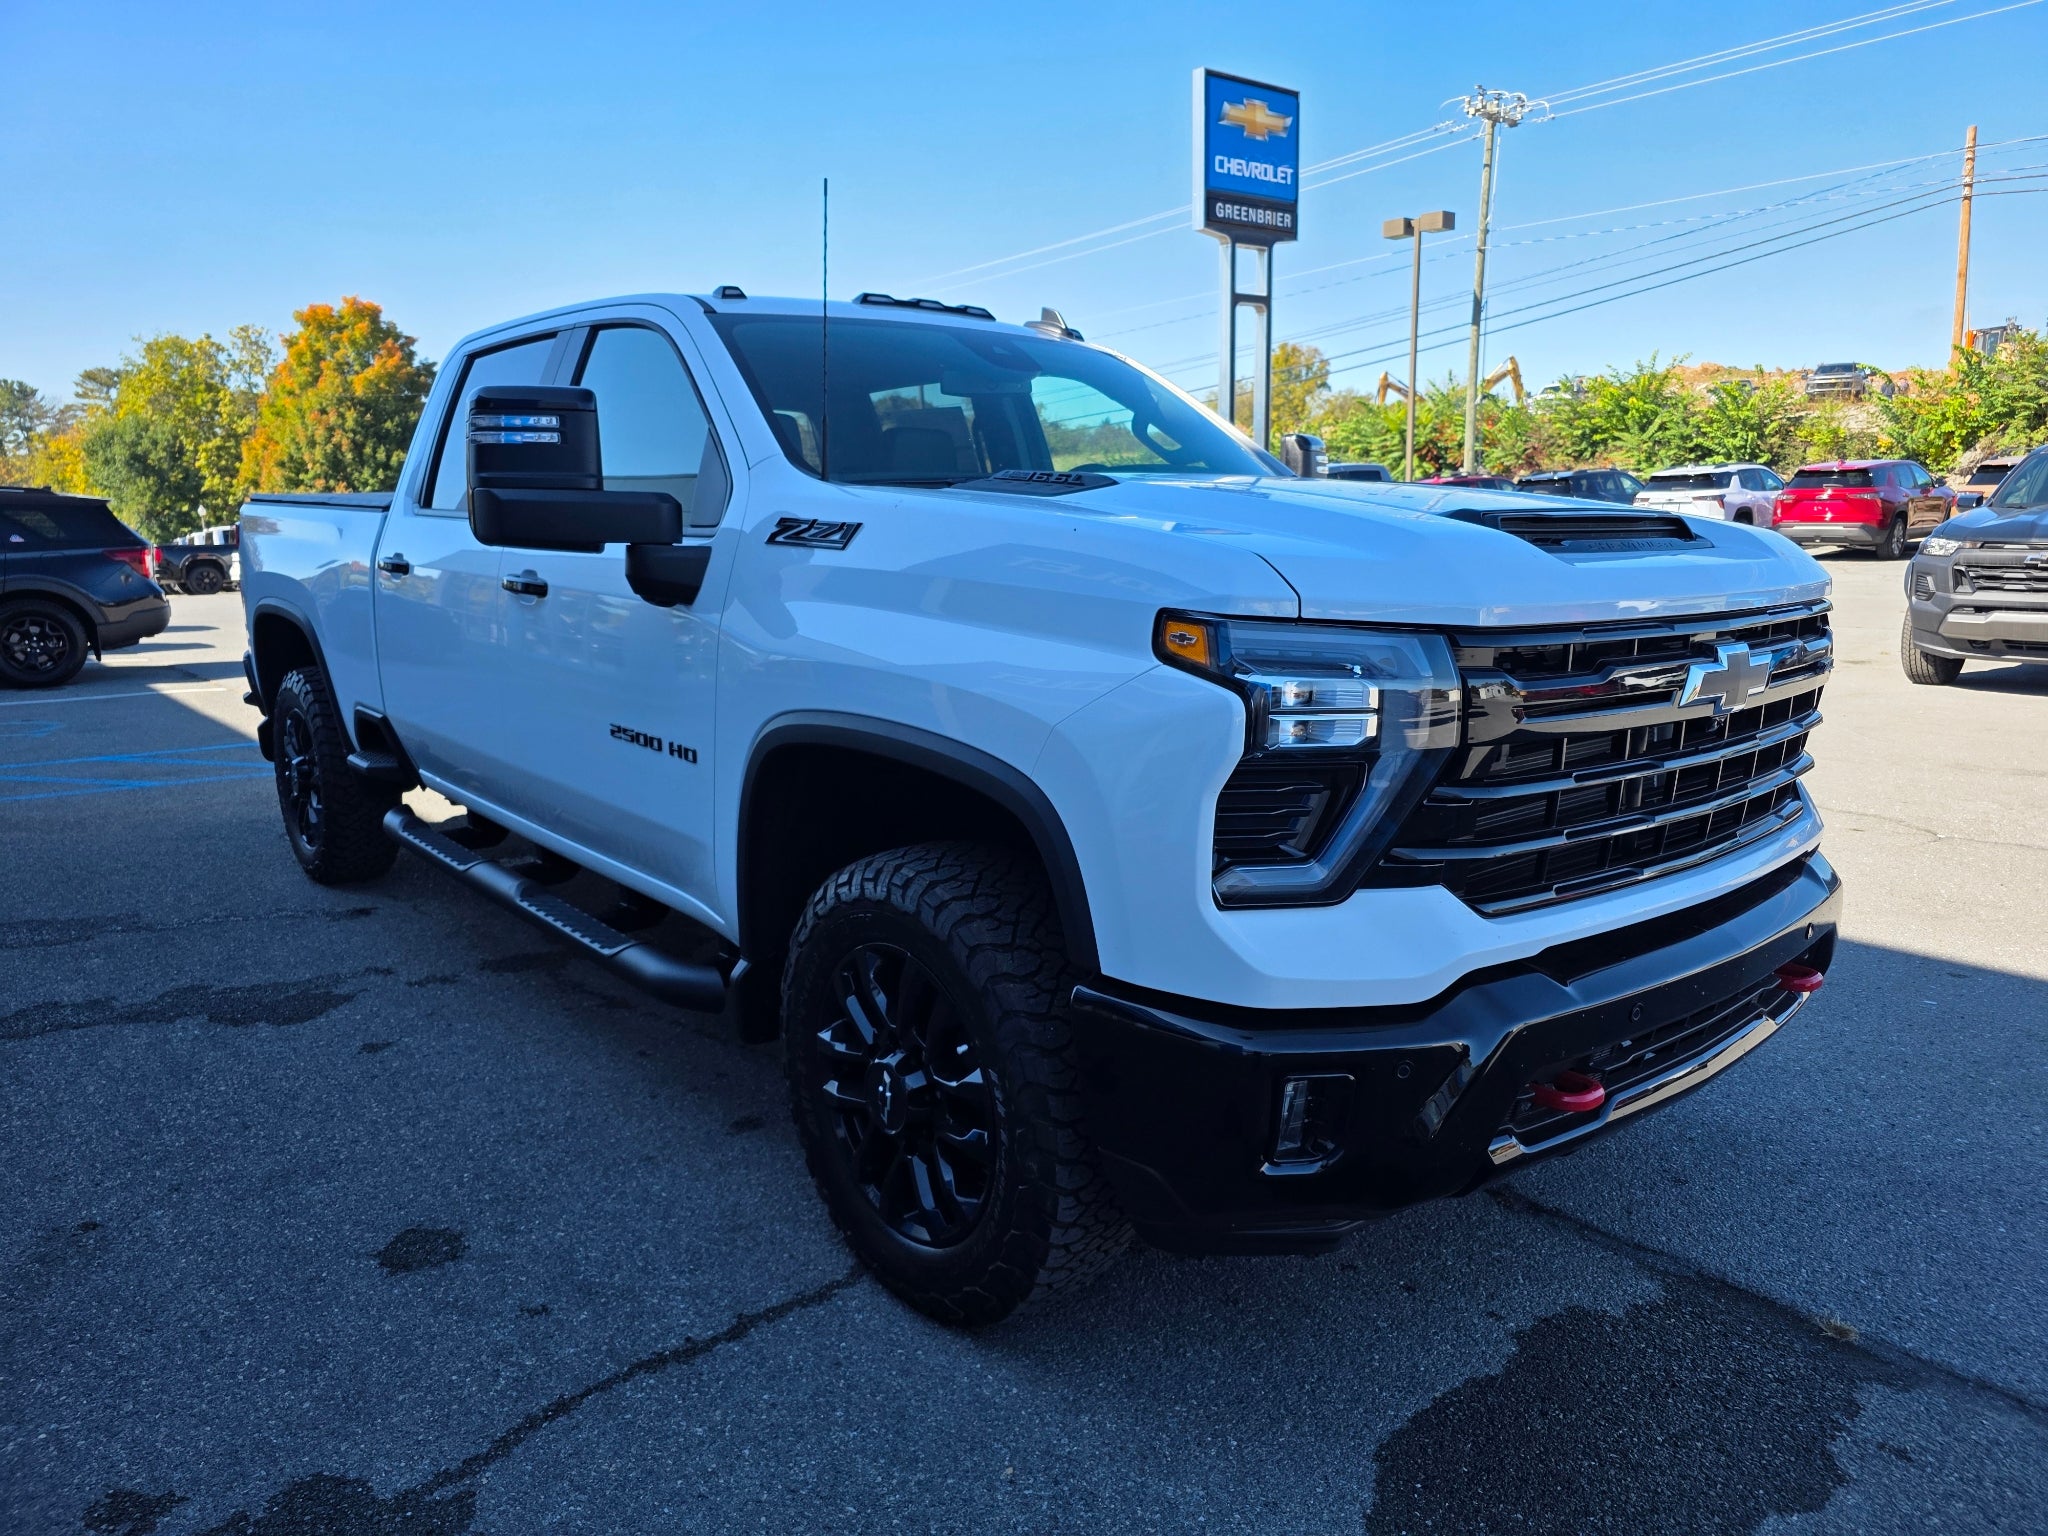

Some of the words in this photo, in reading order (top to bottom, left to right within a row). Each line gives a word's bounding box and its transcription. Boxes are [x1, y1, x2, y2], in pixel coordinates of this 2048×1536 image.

[1214, 155, 1294, 185] CHEVROLET
[1215, 202, 1292, 228] GREENBRIER
[609, 722, 663, 752] 2500
[668, 740, 698, 764] HD
